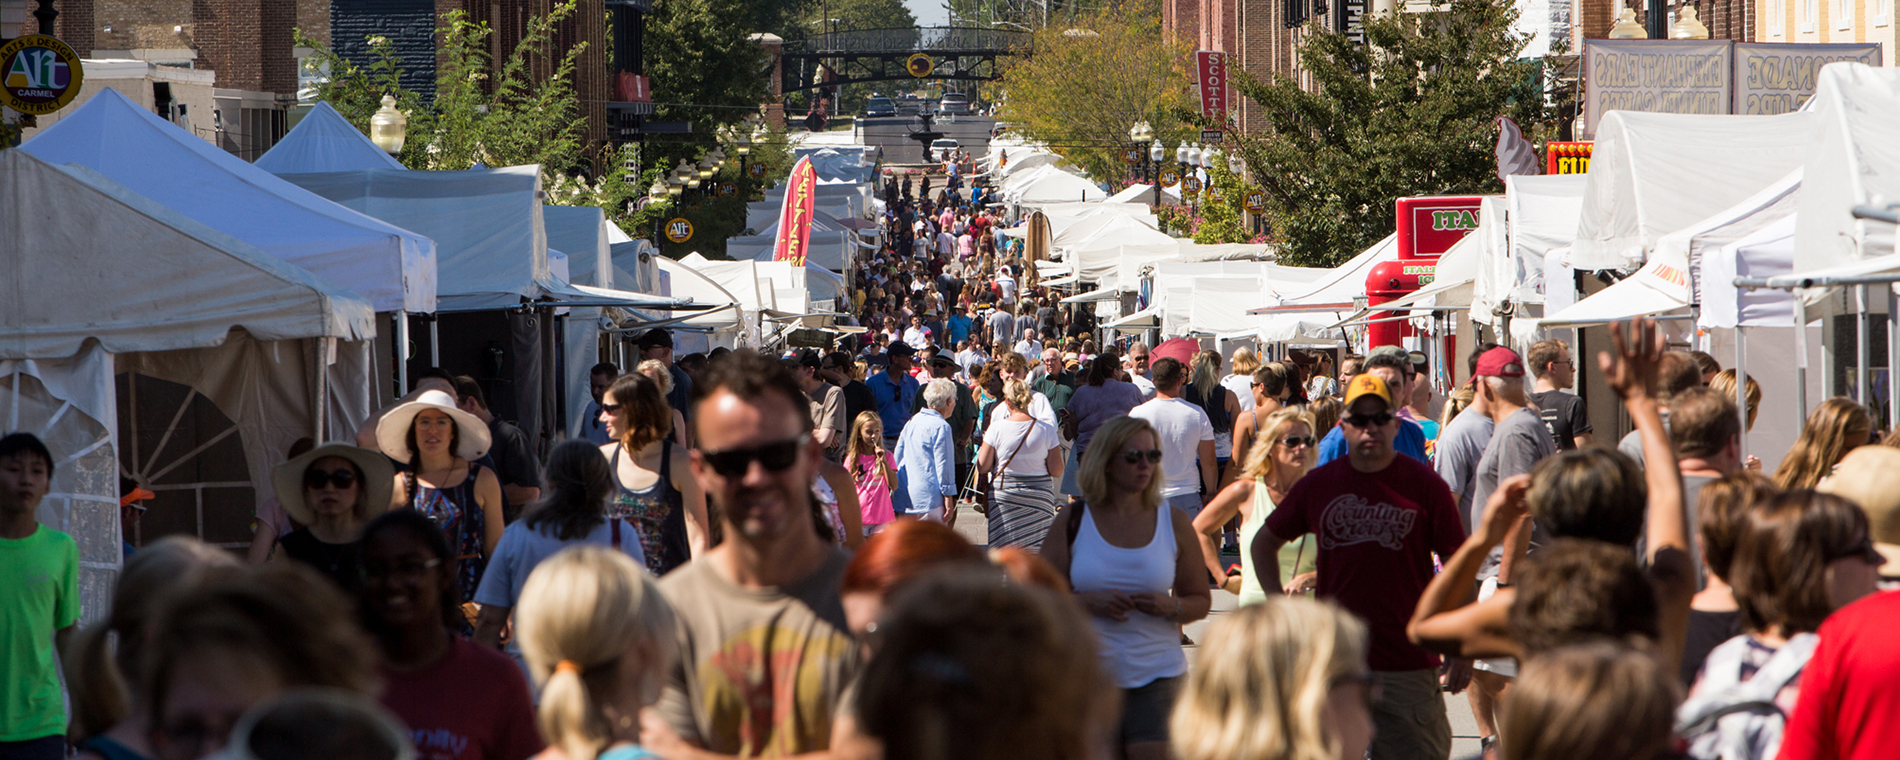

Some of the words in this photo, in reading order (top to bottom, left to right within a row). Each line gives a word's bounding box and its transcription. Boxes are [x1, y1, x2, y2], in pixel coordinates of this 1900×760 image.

[1347, 5, 1364, 44] PINT
[1, 40, 25, 60] ARTS
[26, 38, 34, 46] &
[37, 38, 74, 61] DESIGN
[10, 98, 60, 112] DISTRICT
[18, 89, 56, 98] CARMEL
[788, 161, 813, 255] KETTLE
